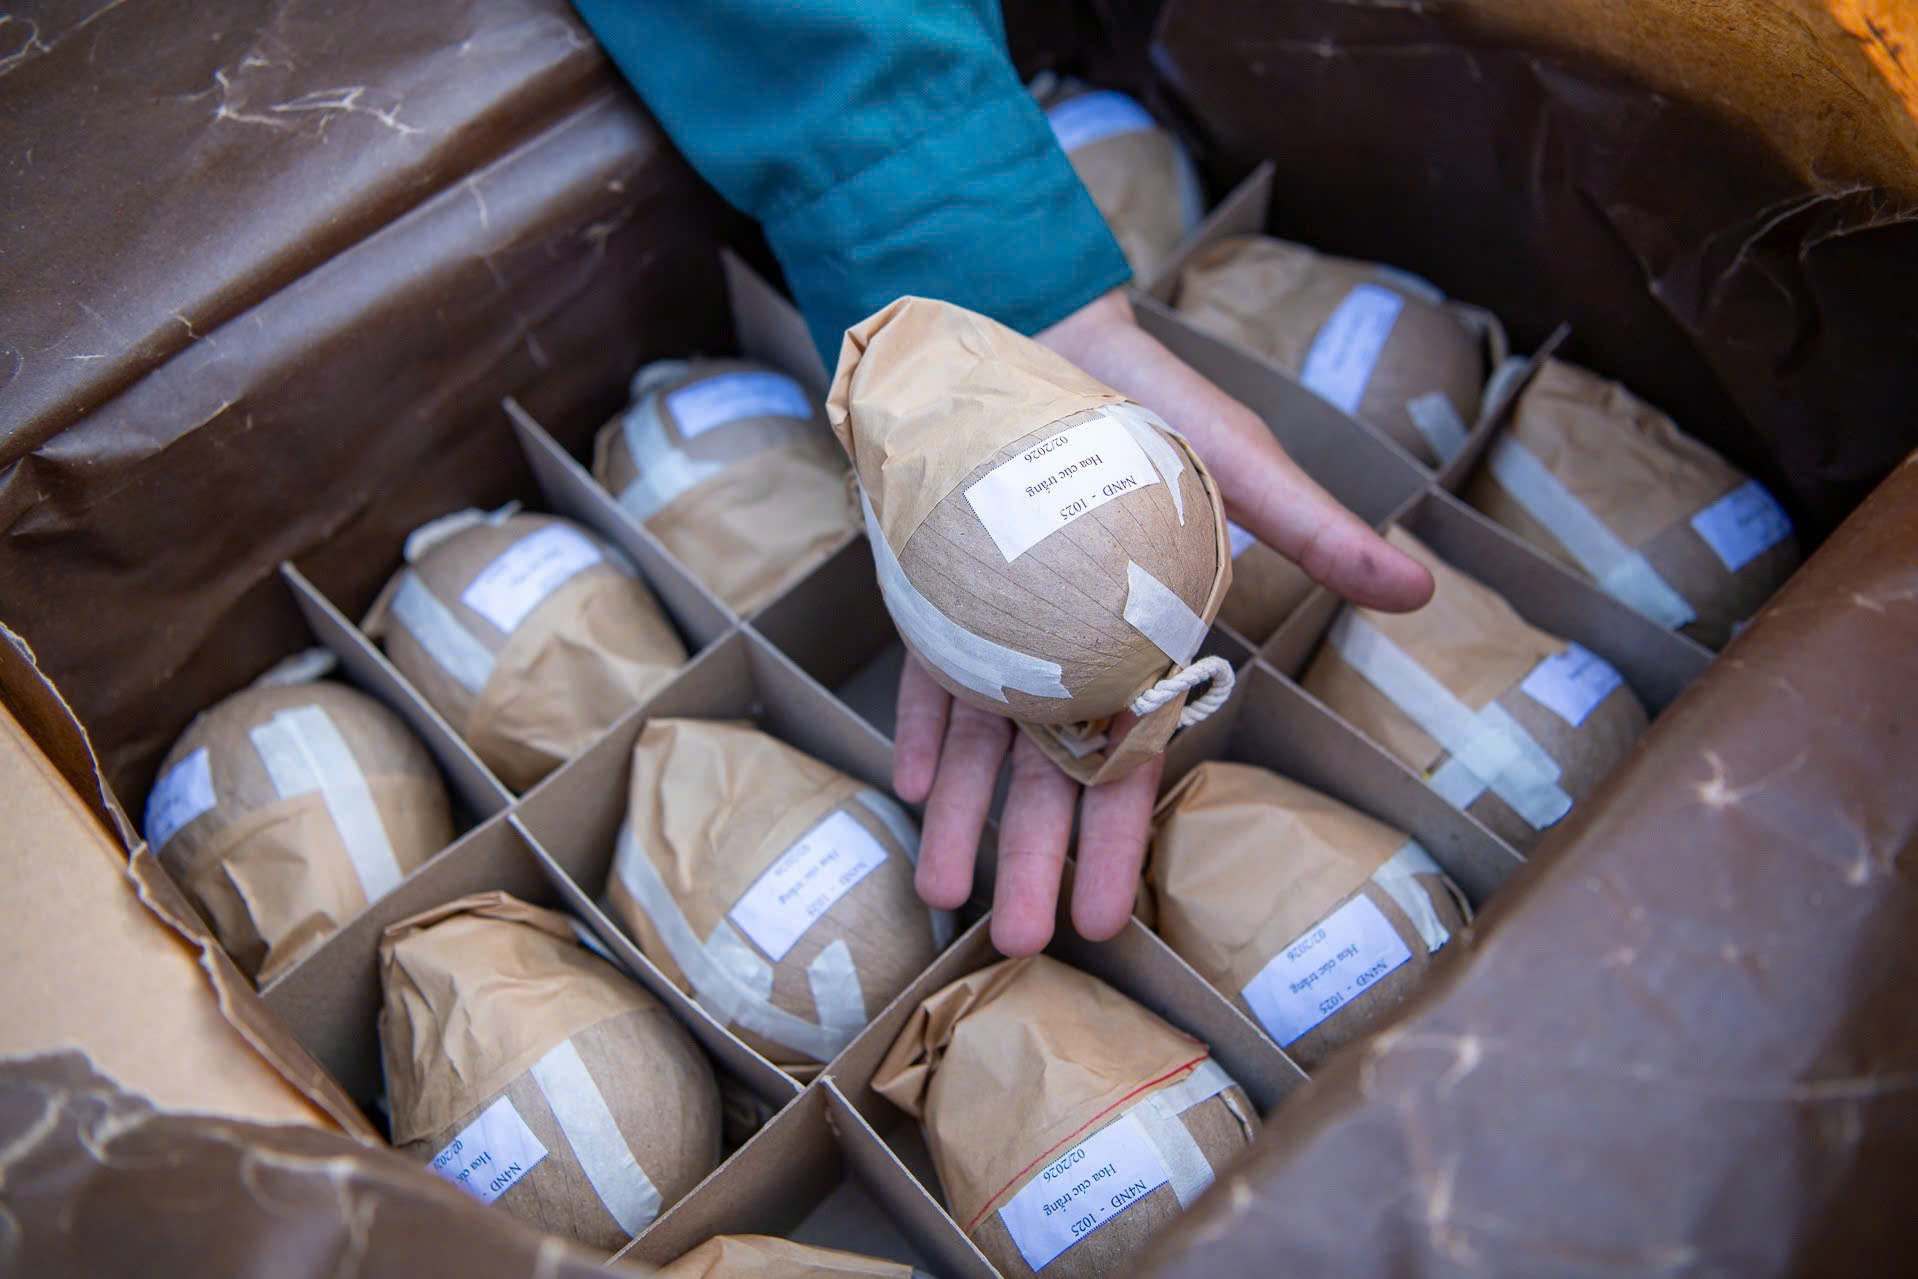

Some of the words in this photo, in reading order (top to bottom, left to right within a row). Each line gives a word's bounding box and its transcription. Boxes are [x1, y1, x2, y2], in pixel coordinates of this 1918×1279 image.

[1024, 435, 1069, 463] 02/2026
[1059, 463, 1077, 480] cúc
[1079, 453, 1103, 468] Hoa
[1025, 474, 1056, 500] trắng
[1060, 498, 1087, 520] 1025
[1336, 944, 1358, 961] Hoa
[1318, 992, 1344, 1014] 1025
[470, 1152, 491, 1168] Hoa
[1043, 1149, 1085, 1182] 02/2026
[1092, 1163, 1116, 1182] Hoa
[1072, 1179, 1091, 1197] cúc
[1043, 1192, 1072, 1217] trắng
[1071, 1213, 1097, 1237] 1025
